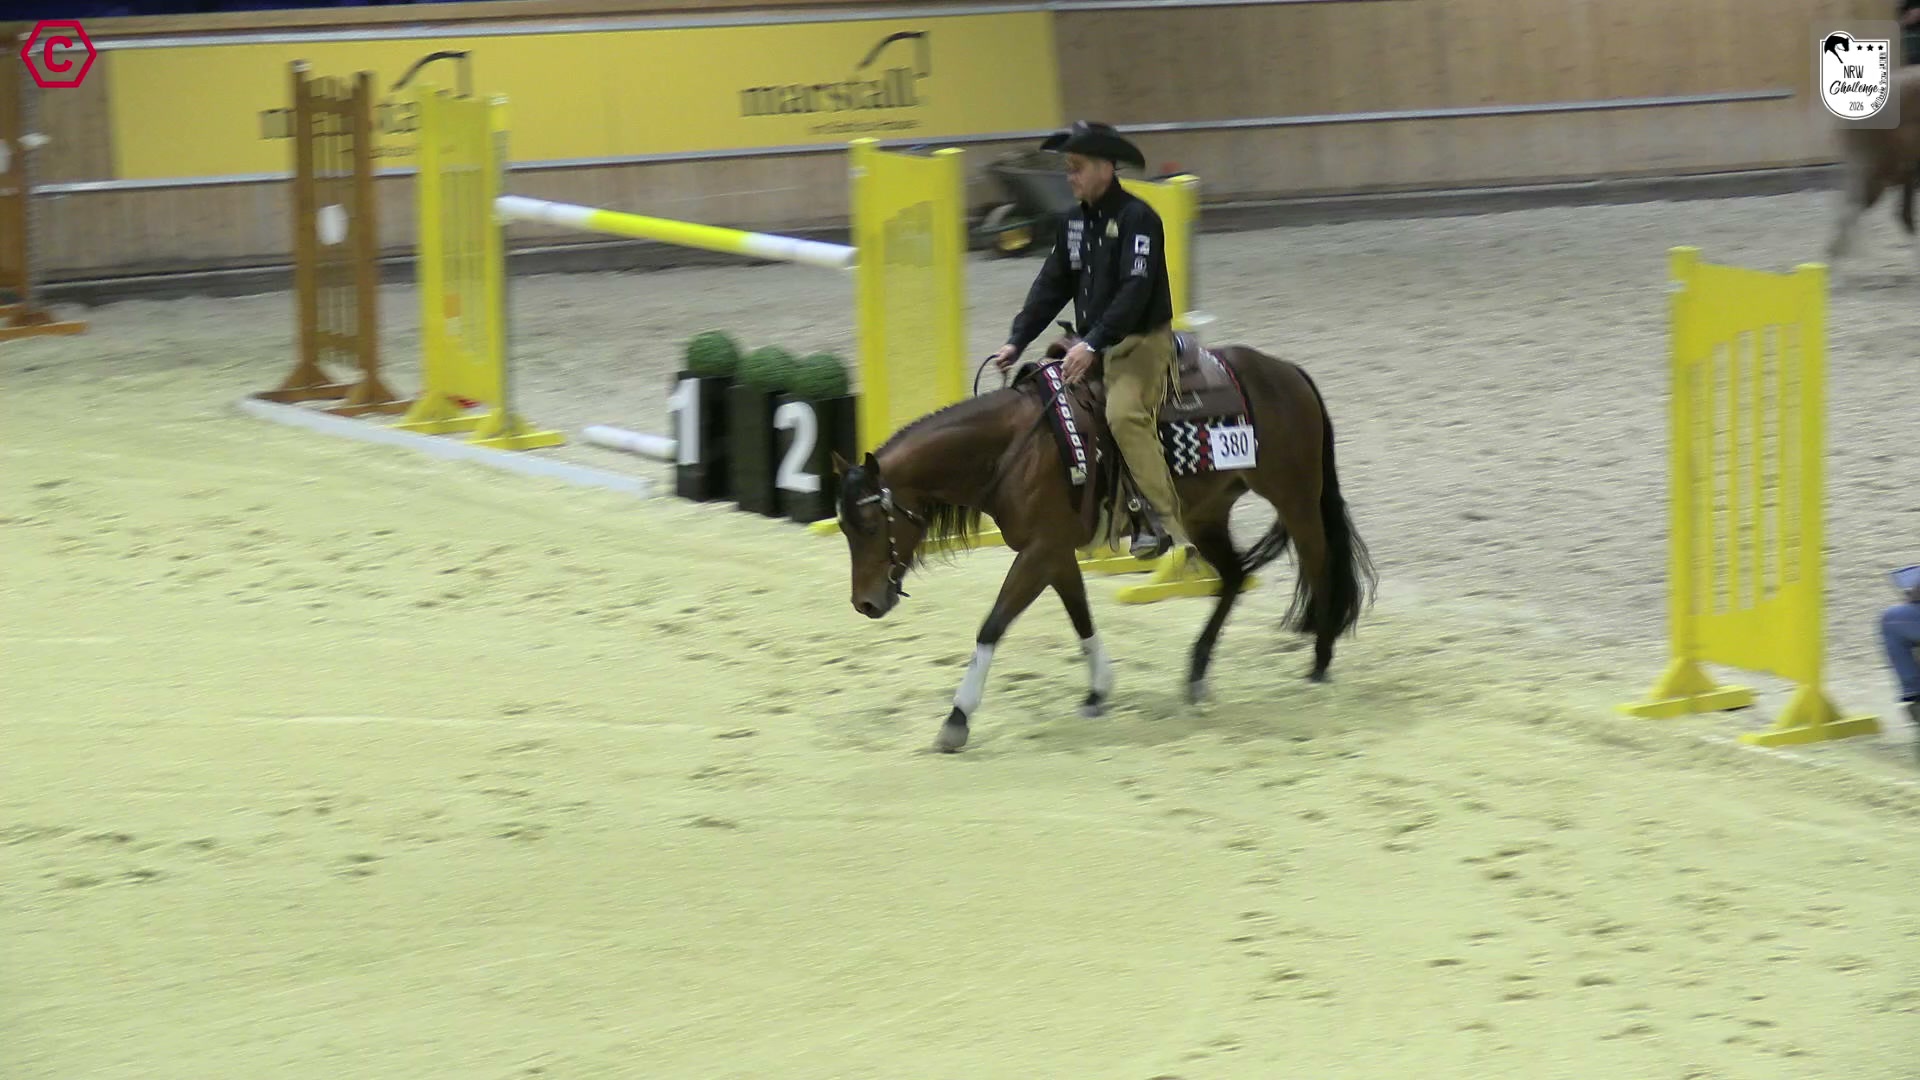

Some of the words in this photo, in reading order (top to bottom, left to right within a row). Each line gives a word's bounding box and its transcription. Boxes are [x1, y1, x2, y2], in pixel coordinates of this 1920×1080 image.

[739, 67, 921, 117] marstall
[667, 377, 700, 465] 1
[773, 401, 821, 493] 2
[1219, 431, 1249, 458] 380
